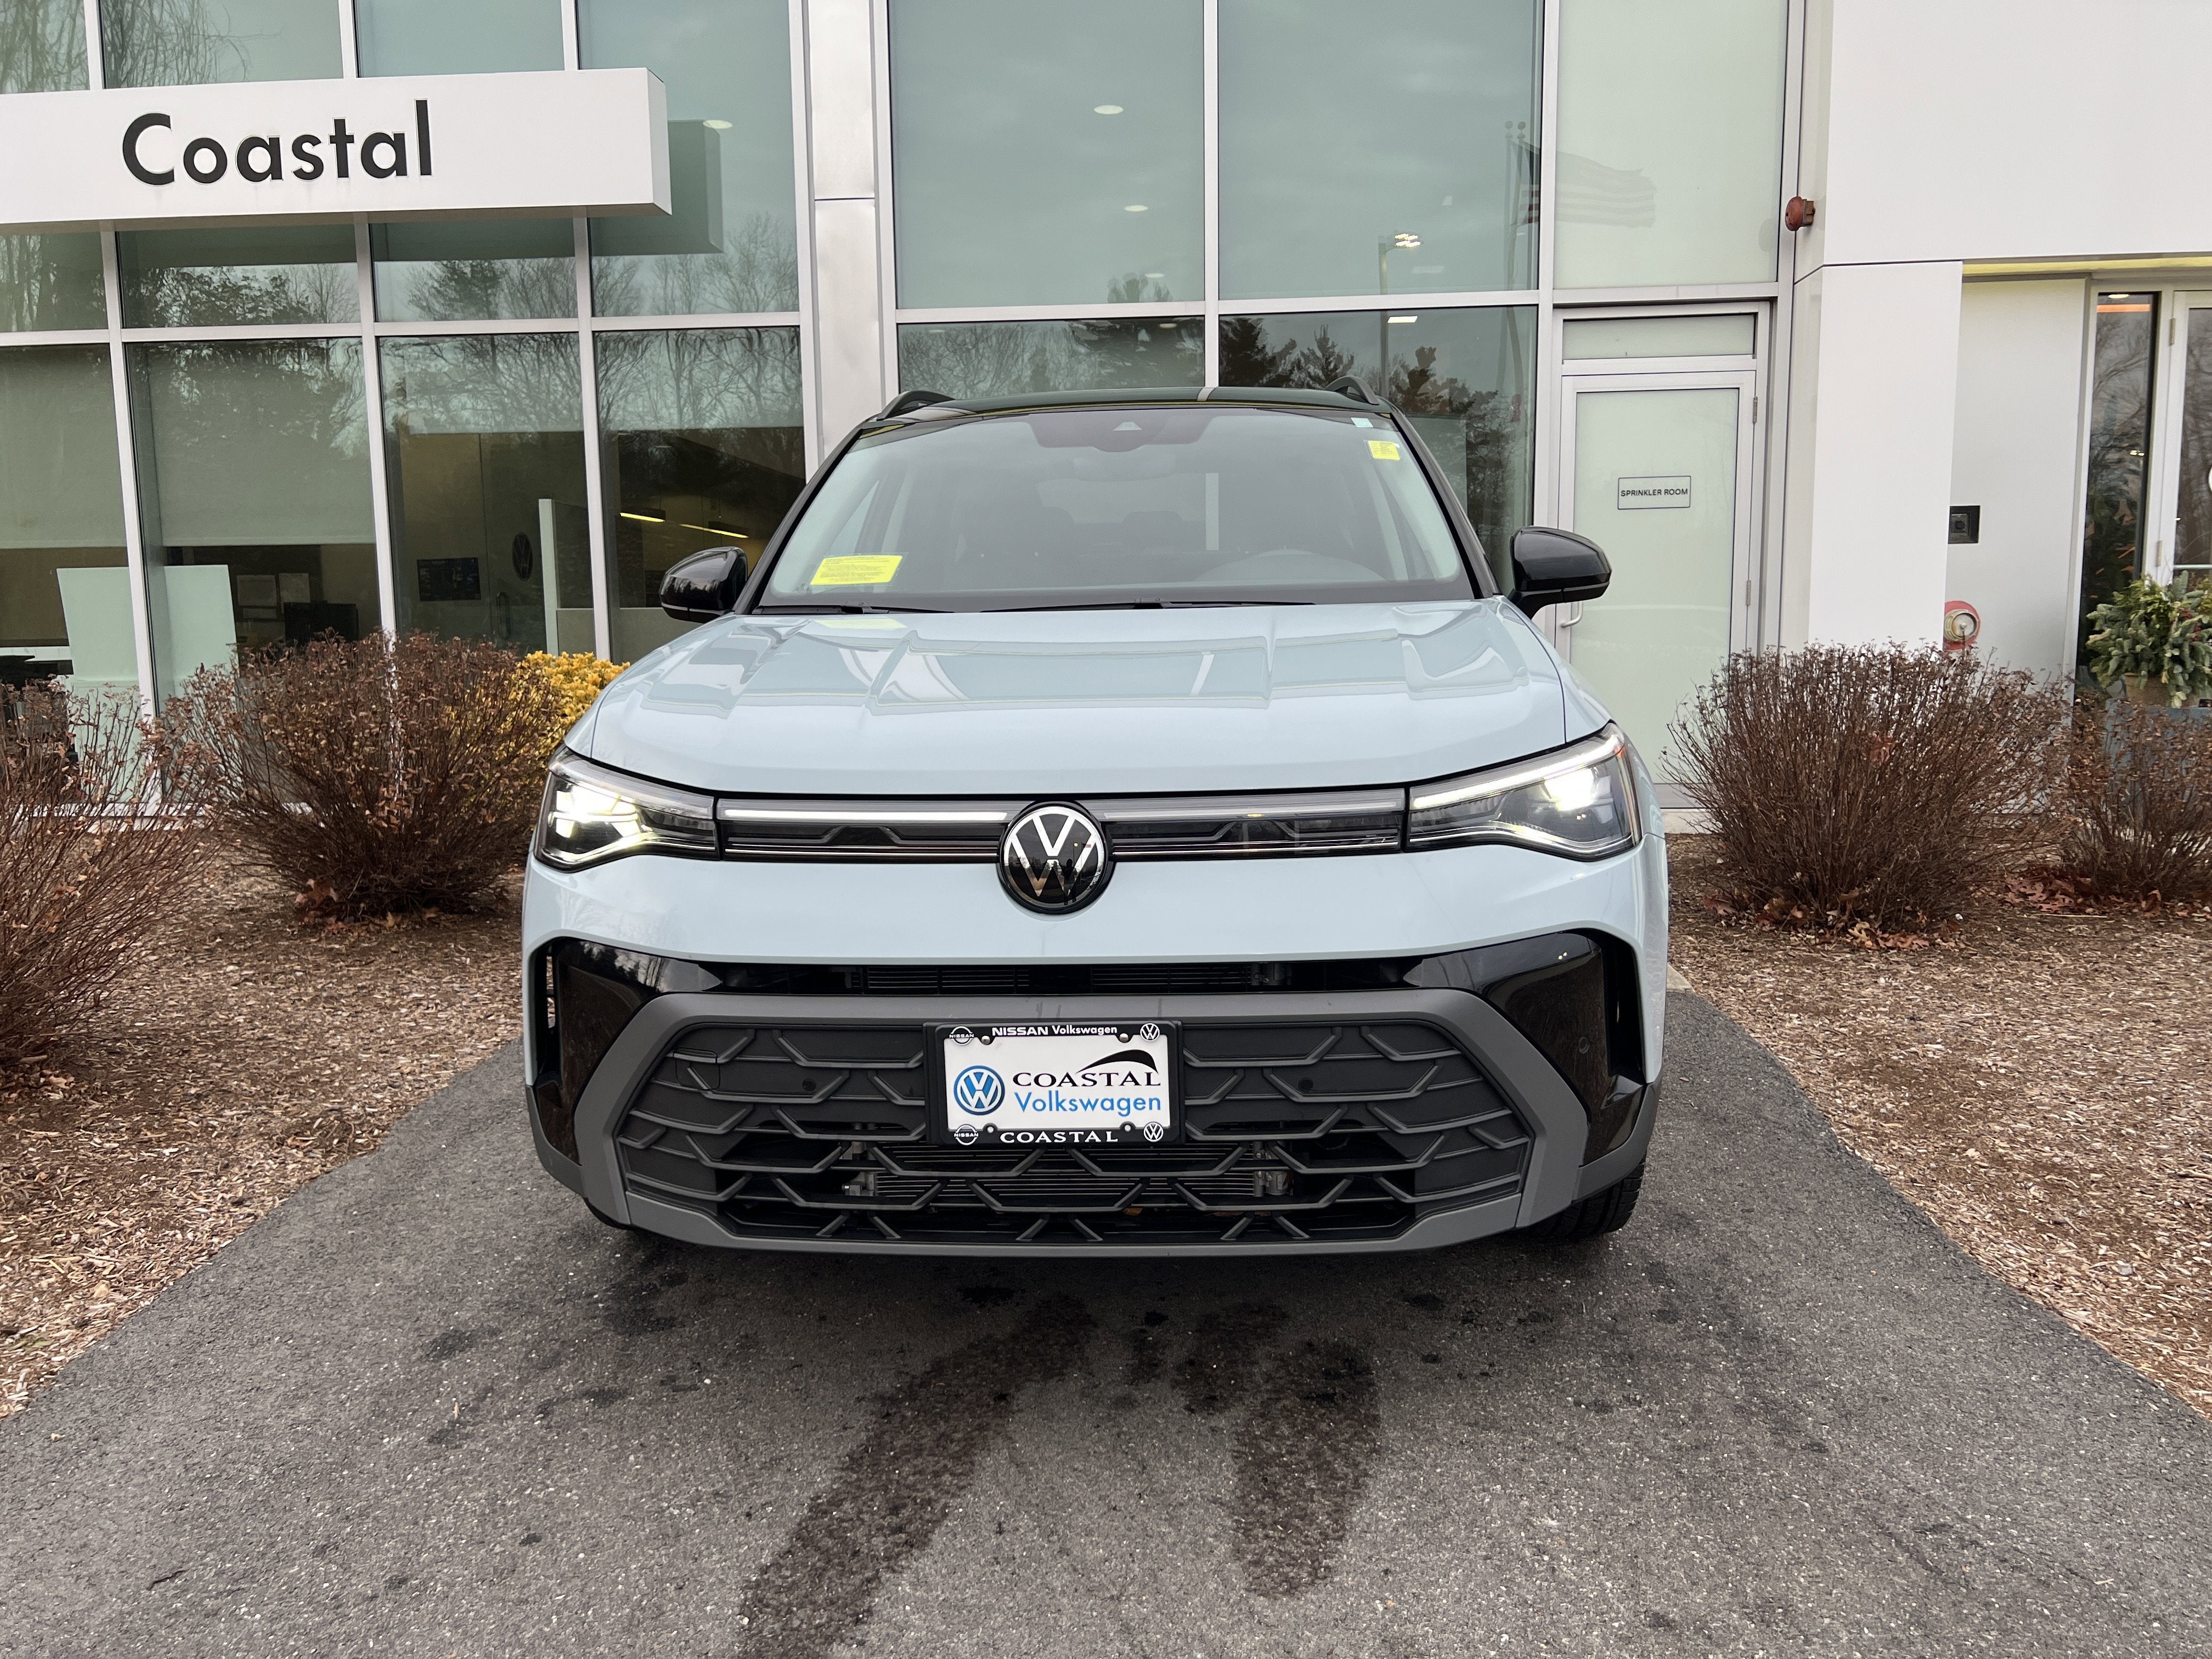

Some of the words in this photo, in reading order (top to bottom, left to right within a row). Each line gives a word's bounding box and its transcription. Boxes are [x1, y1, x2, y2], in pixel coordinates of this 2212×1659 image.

[122, 98, 432, 186] Coastal
[992, 1026, 1048, 1036] NISSAN
[1051, 1024, 1118, 1036] Volkswagen
[1013, 1071, 1161, 1087] COASTAL
[1014, 1090, 1161, 1117] Volkswagen
[1000, 1130, 1118, 1143] COASTAL
